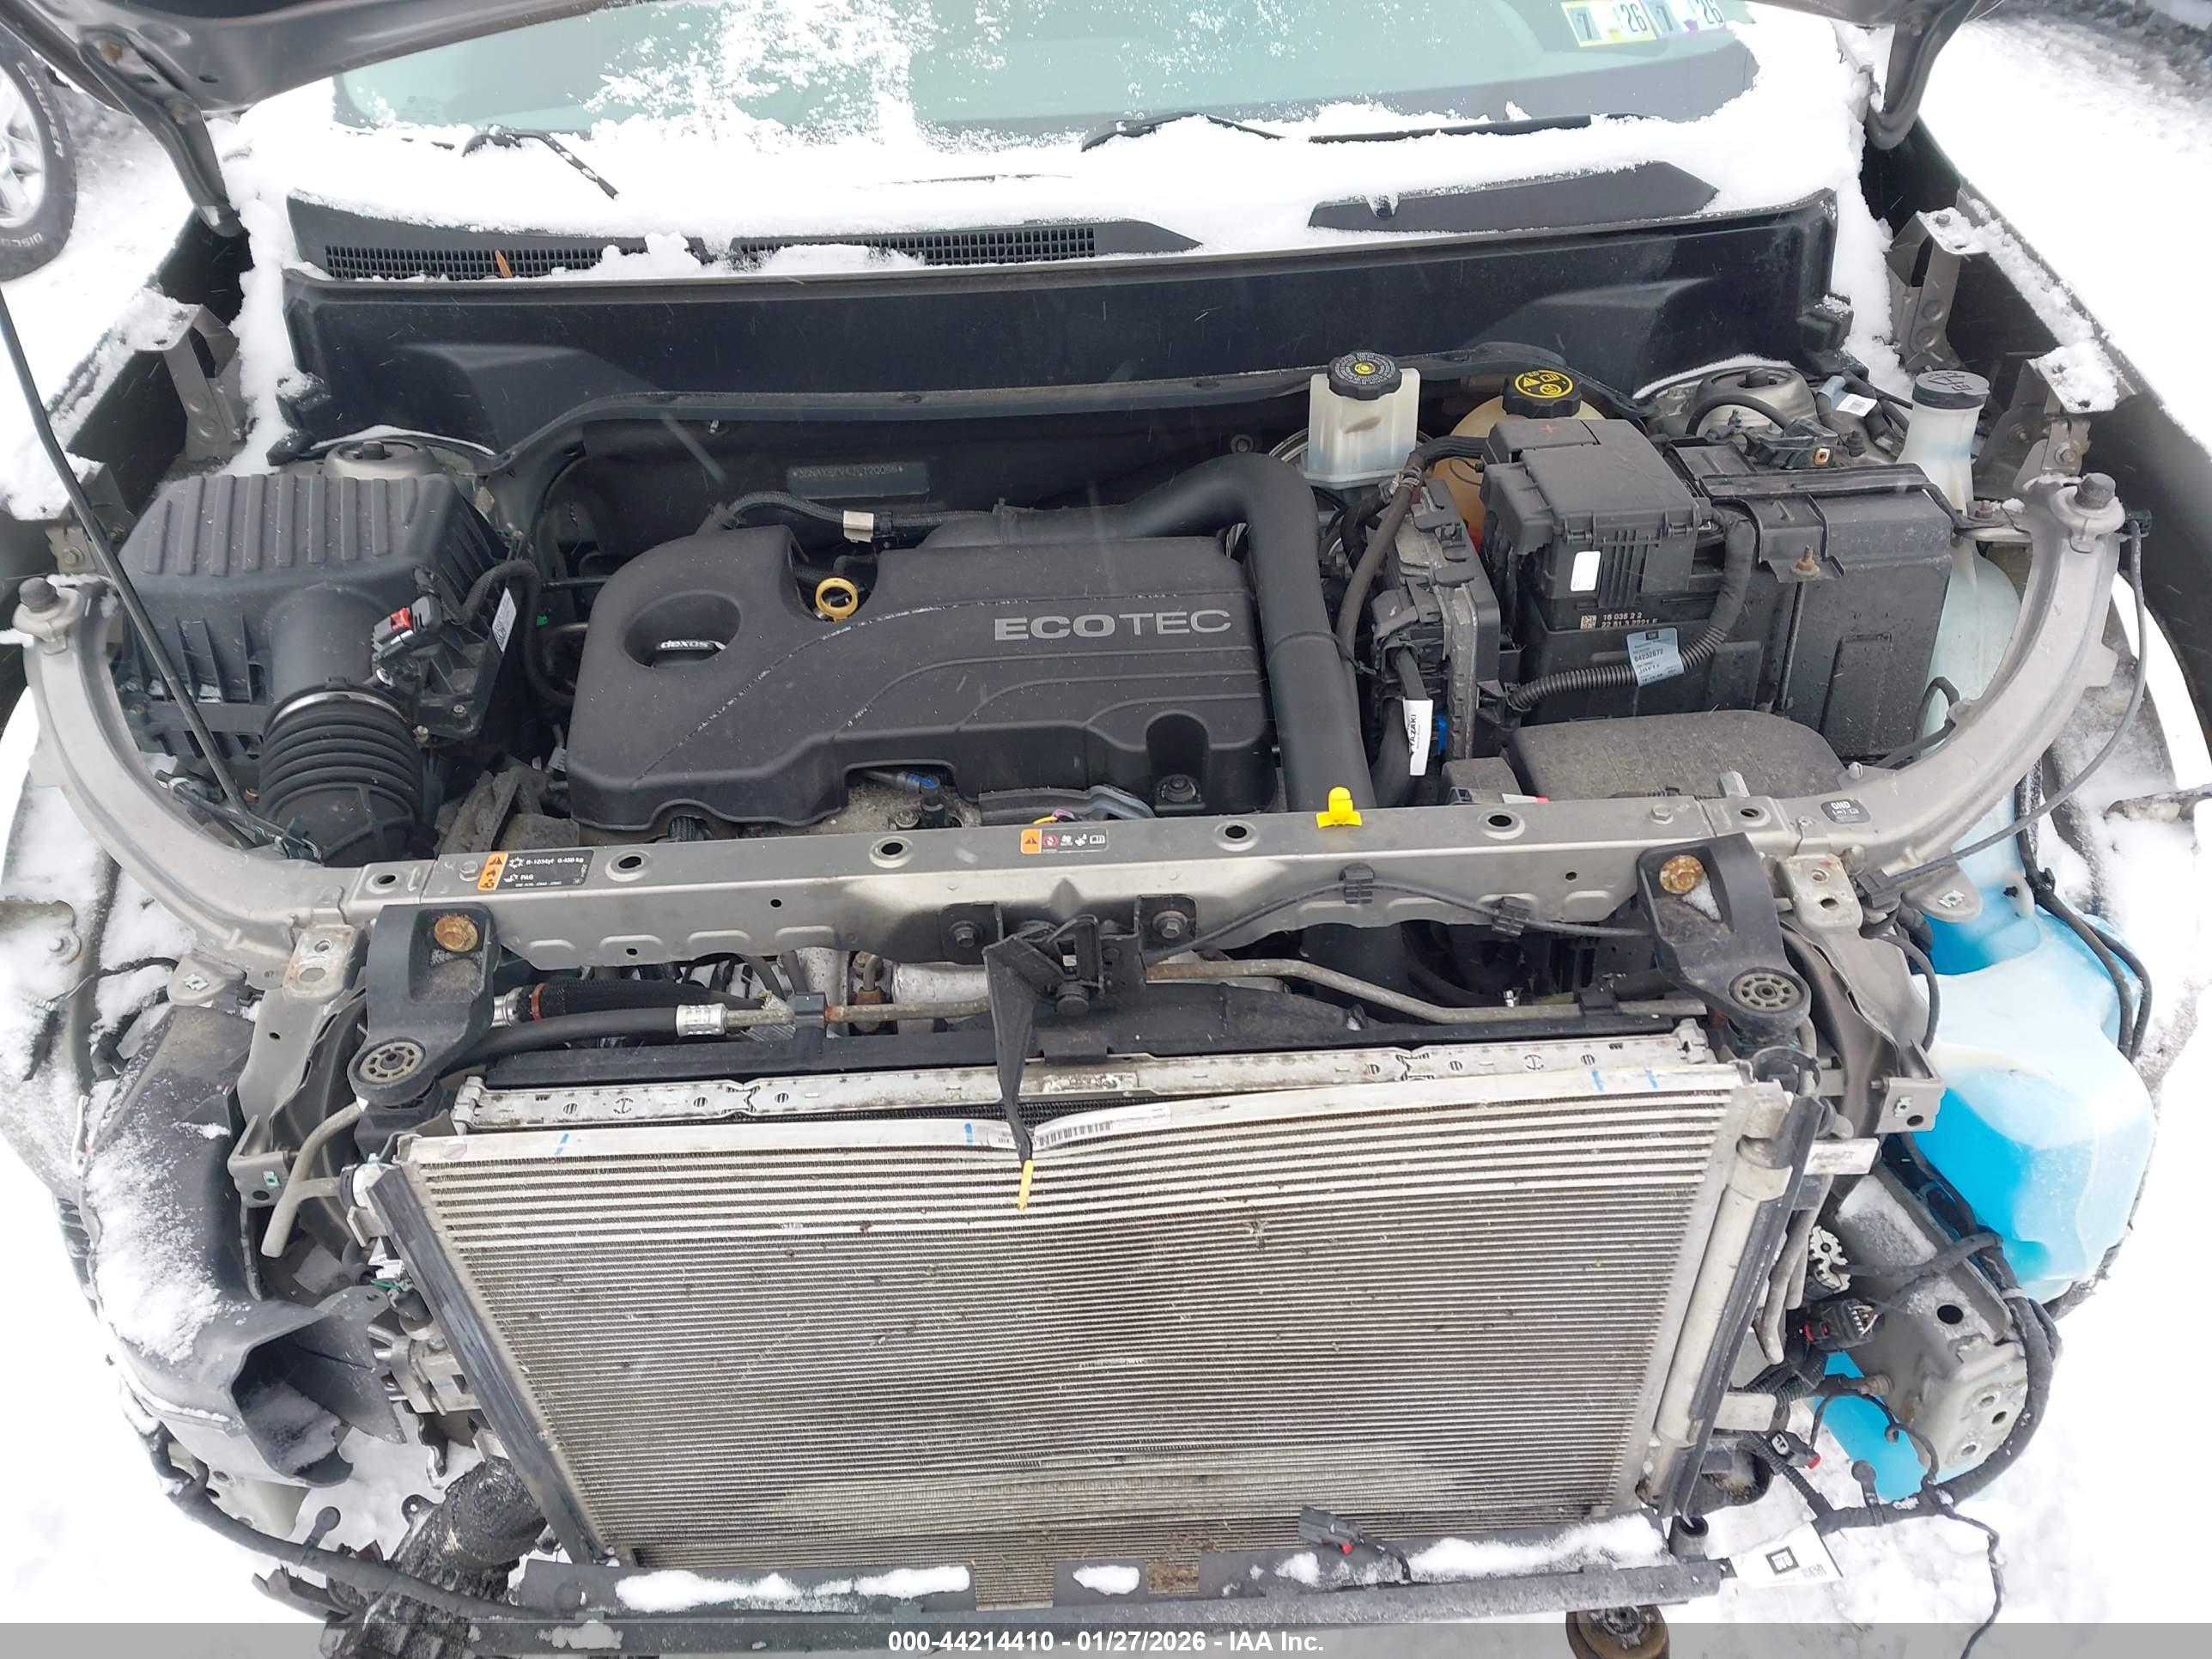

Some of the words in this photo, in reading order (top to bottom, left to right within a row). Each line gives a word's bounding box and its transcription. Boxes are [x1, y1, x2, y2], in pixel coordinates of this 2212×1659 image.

[1577, 12, 1593, 40] 7
[1620, 3, 1648, 33] 26
[1656, 4, 1673, 31] 7
[994, 609, 1232, 641] ECOTEC
